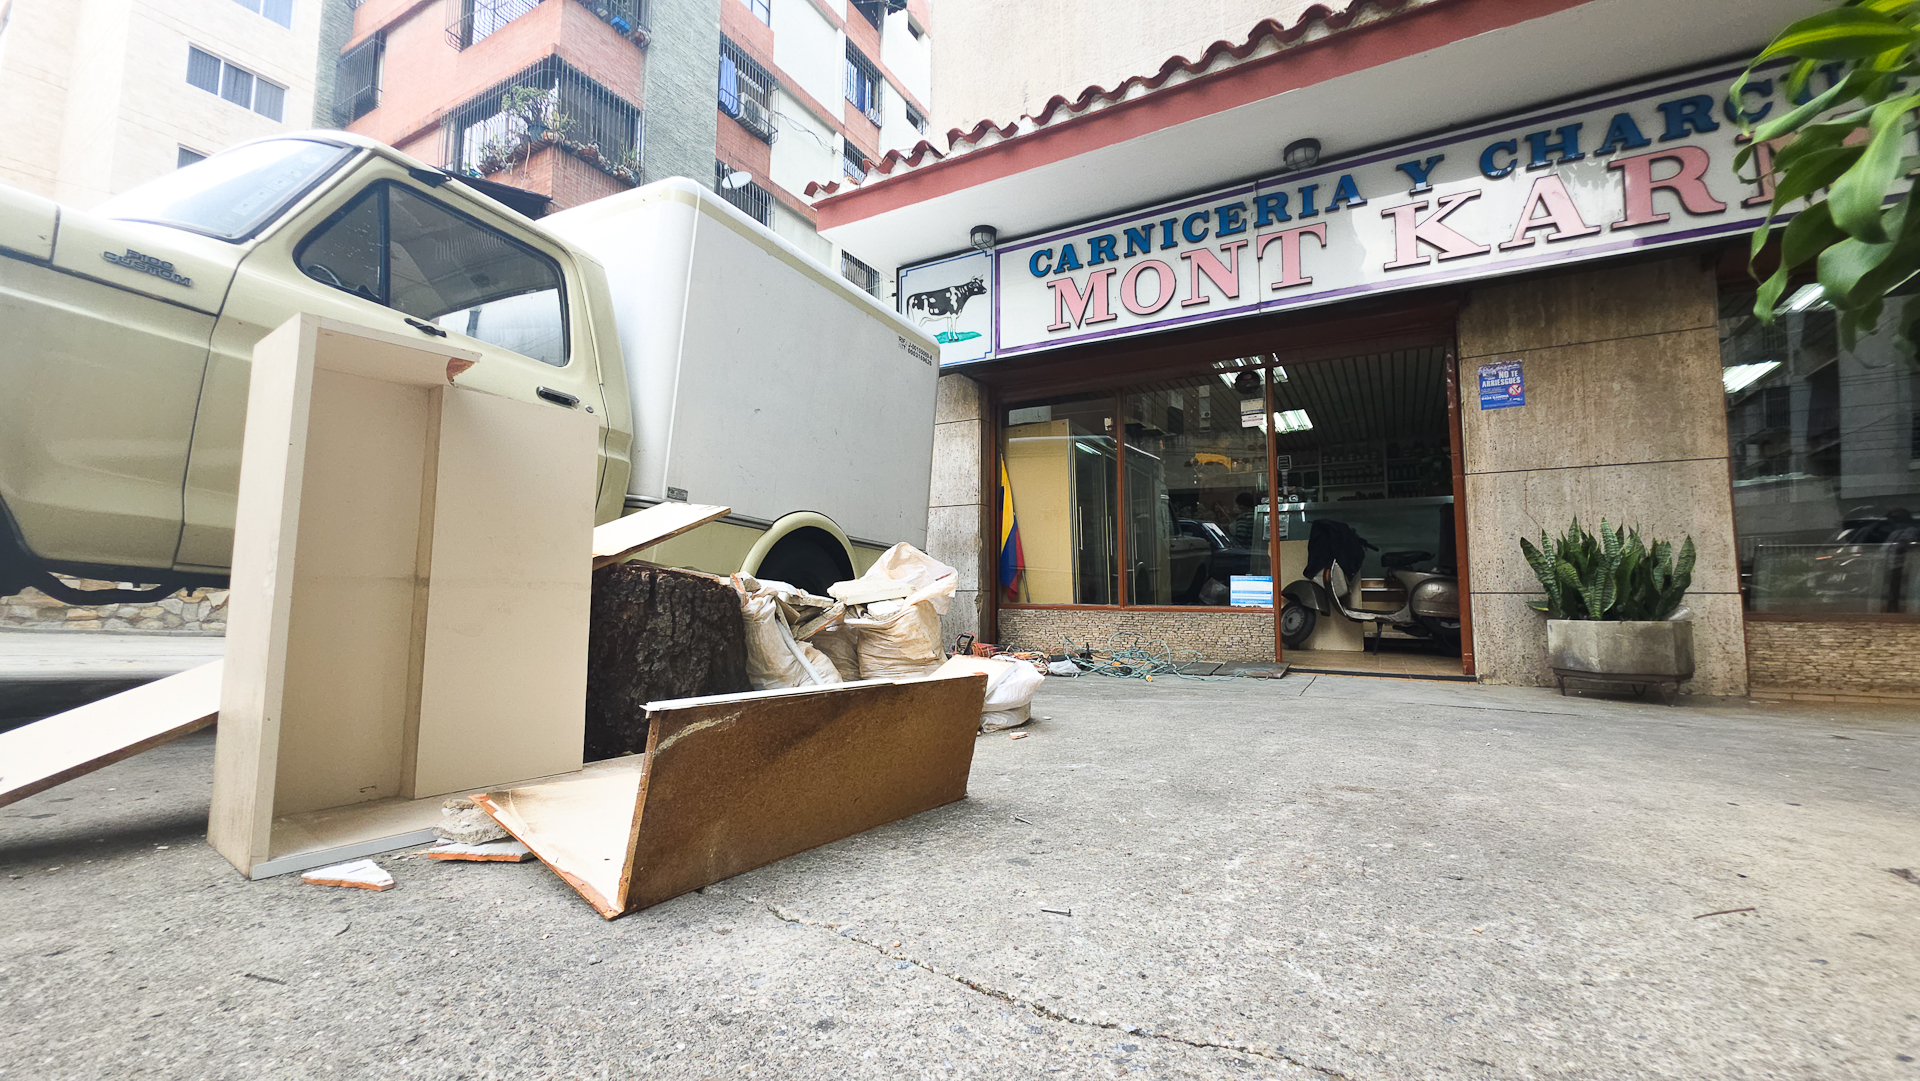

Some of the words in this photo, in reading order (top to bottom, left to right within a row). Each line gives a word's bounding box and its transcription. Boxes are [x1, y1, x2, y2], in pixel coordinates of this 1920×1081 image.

[1029, 174, 1367, 278] CARNICERIA
[1396, 154, 1444, 195] Y
[103, 251, 193, 288] CUSTOM
[1046, 222, 1328, 332] MONT
[1482, 376, 1520, 388] ARRIESGUES
[1498, 370, 1509, 378] NO
